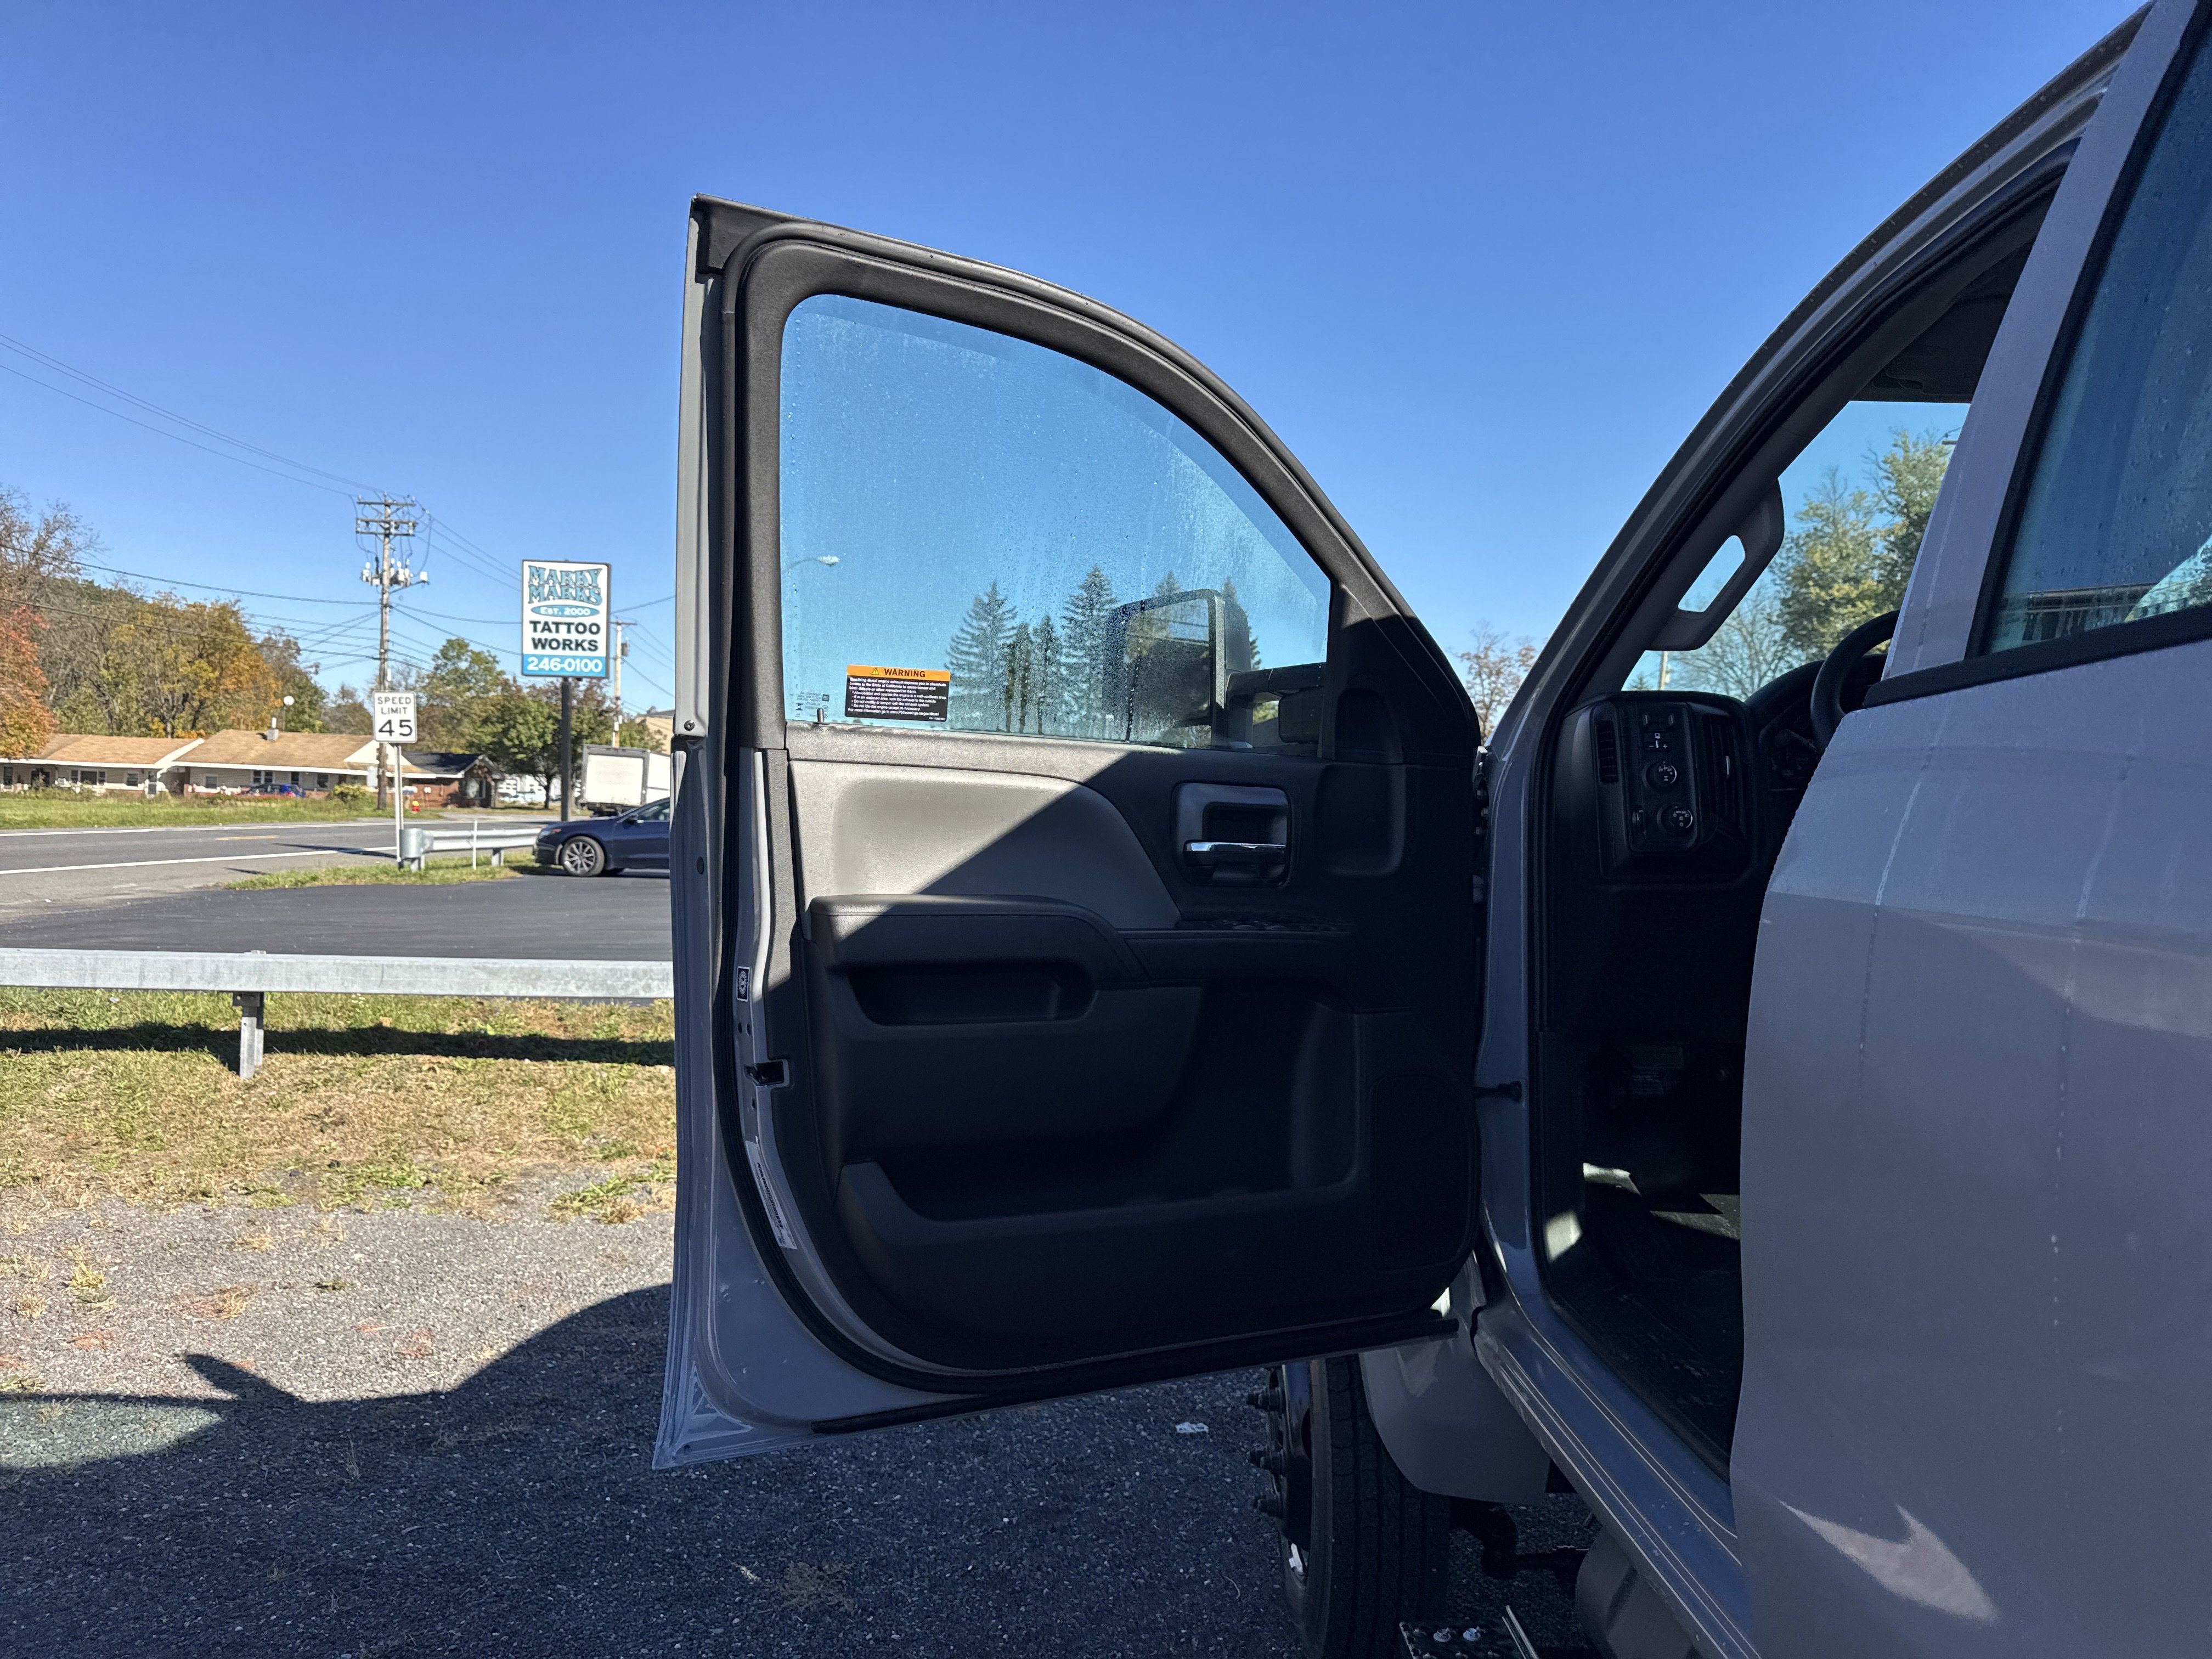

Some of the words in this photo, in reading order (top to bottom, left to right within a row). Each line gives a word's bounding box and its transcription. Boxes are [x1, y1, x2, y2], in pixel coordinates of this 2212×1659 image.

[528, 565, 603, 586] MARKY
[528, 585, 603, 606] MARKS
[564, 607, 591, 616] 2000
[529, 620, 601, 635] TATTOO
[531, 637, 599, 652] WORKS
[527, 657, 602, 673] 246-0100
[884, 668, 926, 678] WARNING
[377, 696, 411, 704] SPEED
[378, 719, 413, 736] 45
